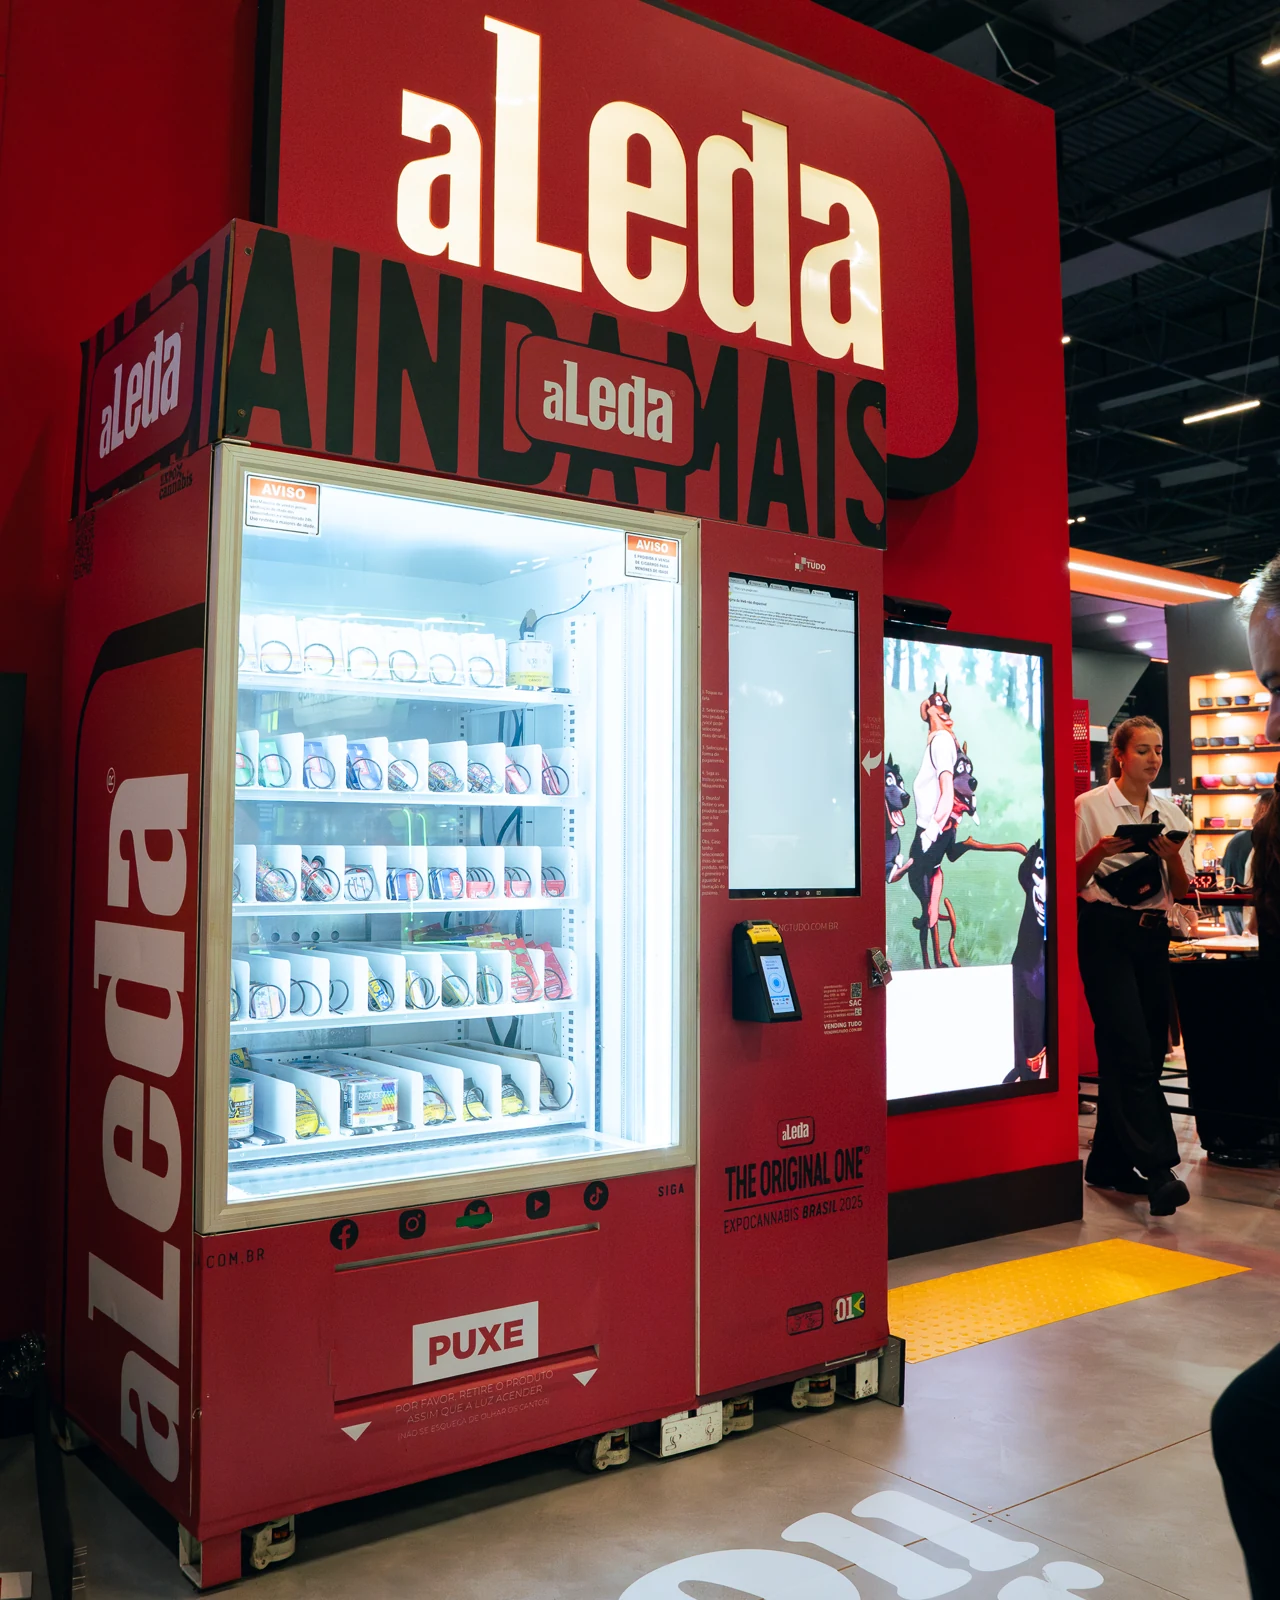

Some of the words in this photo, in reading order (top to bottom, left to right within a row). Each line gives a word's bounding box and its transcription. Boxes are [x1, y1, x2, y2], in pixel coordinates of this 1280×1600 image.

[397, 15, 884, 370] aLeda
[99, 329, 182, 459] aLeda
[543, 359, 673, 444] aLeda
[666, 331, 887, 548] MAIS
[261, 483, 306, 500] AVISO
[636, 539, 669, 553] AVISO
[806, 561, 826, 571] TUDO
[849, 999, 862, 1007] SAC
[824, 1022, 847, 1030] VENDING
[848, 1020, 862, 1028] TUDO
[88, 773, 189, 1483] aLeda
[782, 1121, 809, 1142] aLeda
[658, 1183, 684, 1197] SIGA
[724, 1162, 757, 1202] THE
[759, 1151, 831, 1197] ORIGINAL
[724, 1207, 799, 1234] EXPOCANNABIS
[802, 1199, 837, 1220] BRASIL
[839, 1194, 864, 1213] 2025
[206, 1247, 265, 1269] COM.BR
[835, 1296, 855, 1321] 01
[429, 1319, 524, 1366] PUXE
[395, 1401, 418, 1414] POR
[420, 1392, 457, 1409] FAVOR,
[459, 1384, 493, 1400] RETIRE
[496, 1381, 504, 1391] O
[506, 1370, 554, 1388] PRODUTO
[407, 1409, 439, 1424] ASSIM
[441, 1405, 463, 1417] QUE
[464, 1402, 473, 1411] A
[475, 1396, 494, 1409] LUZ
[495, 1384, 543, 1403] ACENDER
[419, 1426, 429, 1436] SE
[468, 1415, 480, 1424] DE
[480, 1407, 507, 1421] OLHAR
